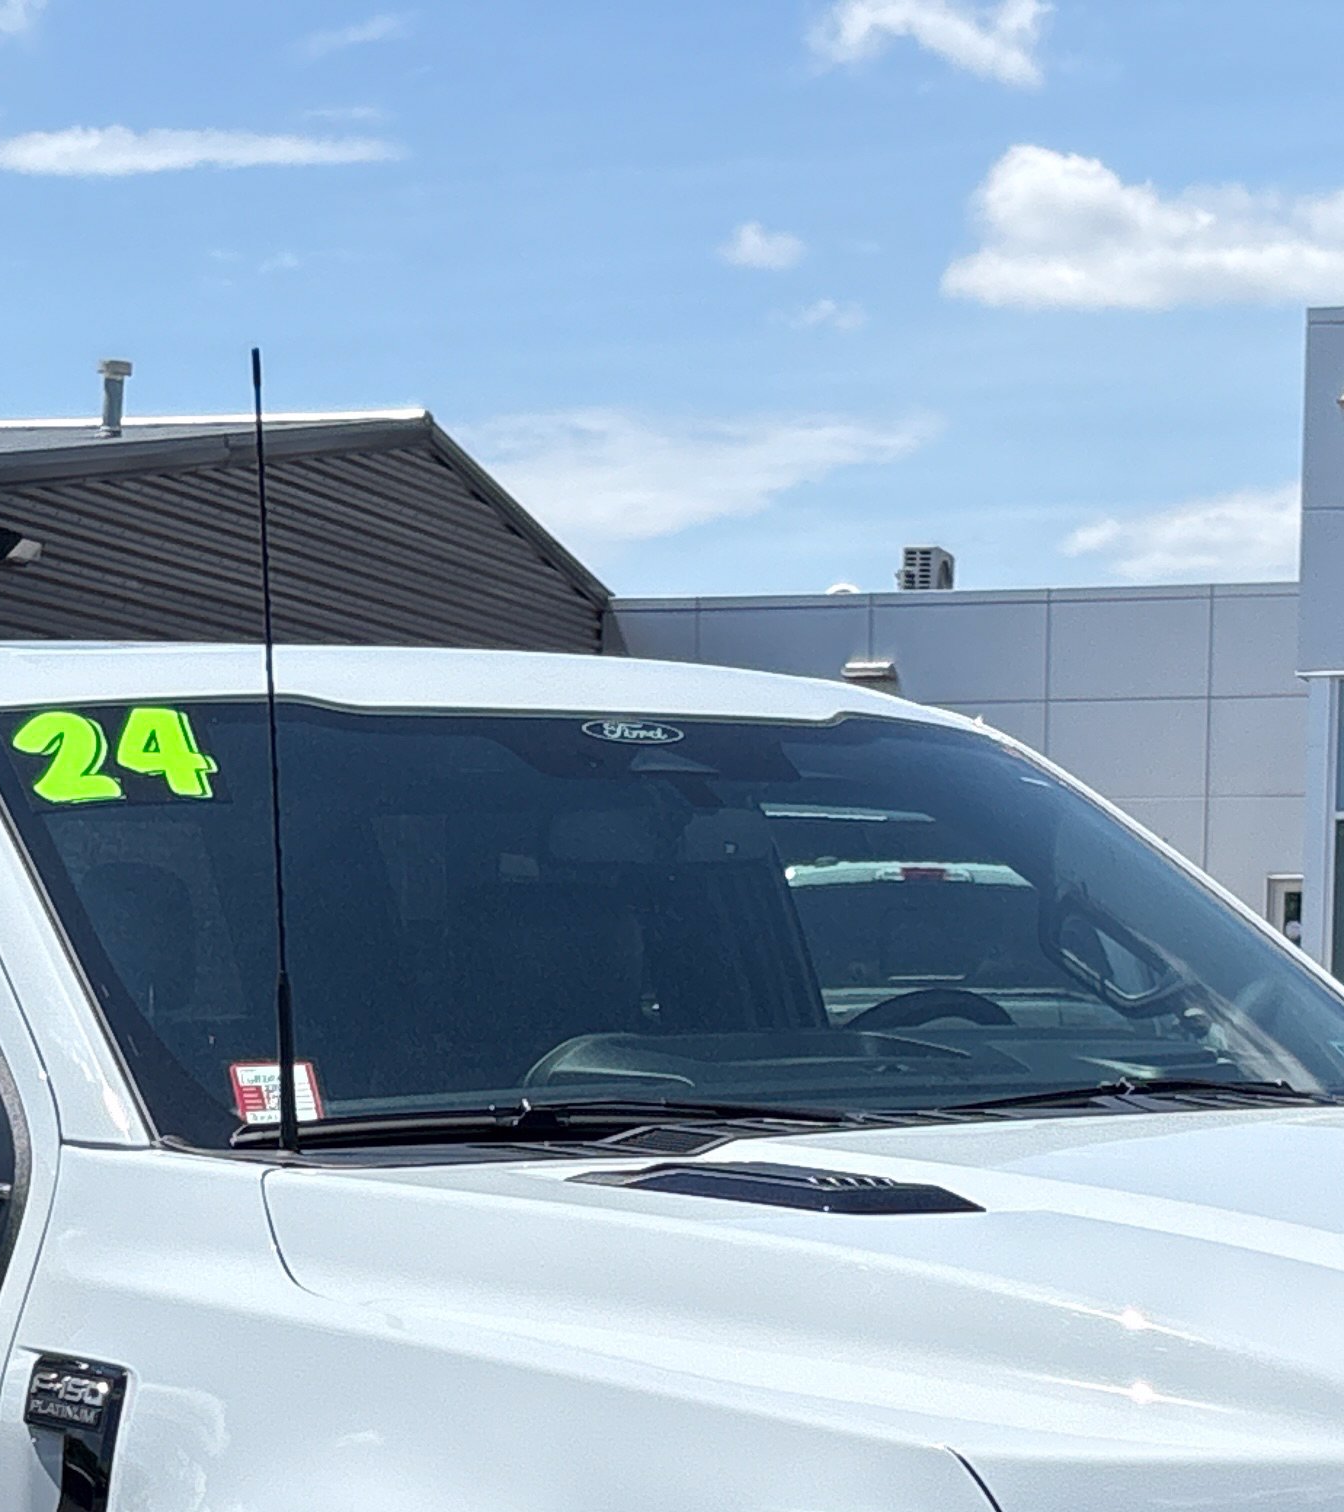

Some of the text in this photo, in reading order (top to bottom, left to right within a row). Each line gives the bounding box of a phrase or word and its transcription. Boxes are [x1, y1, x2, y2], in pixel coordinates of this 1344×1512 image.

[601, 722, 668, 740] Ford
[12, 707, 218, 803] 24
[29, 1399, 103, 1424] PLATINUM
